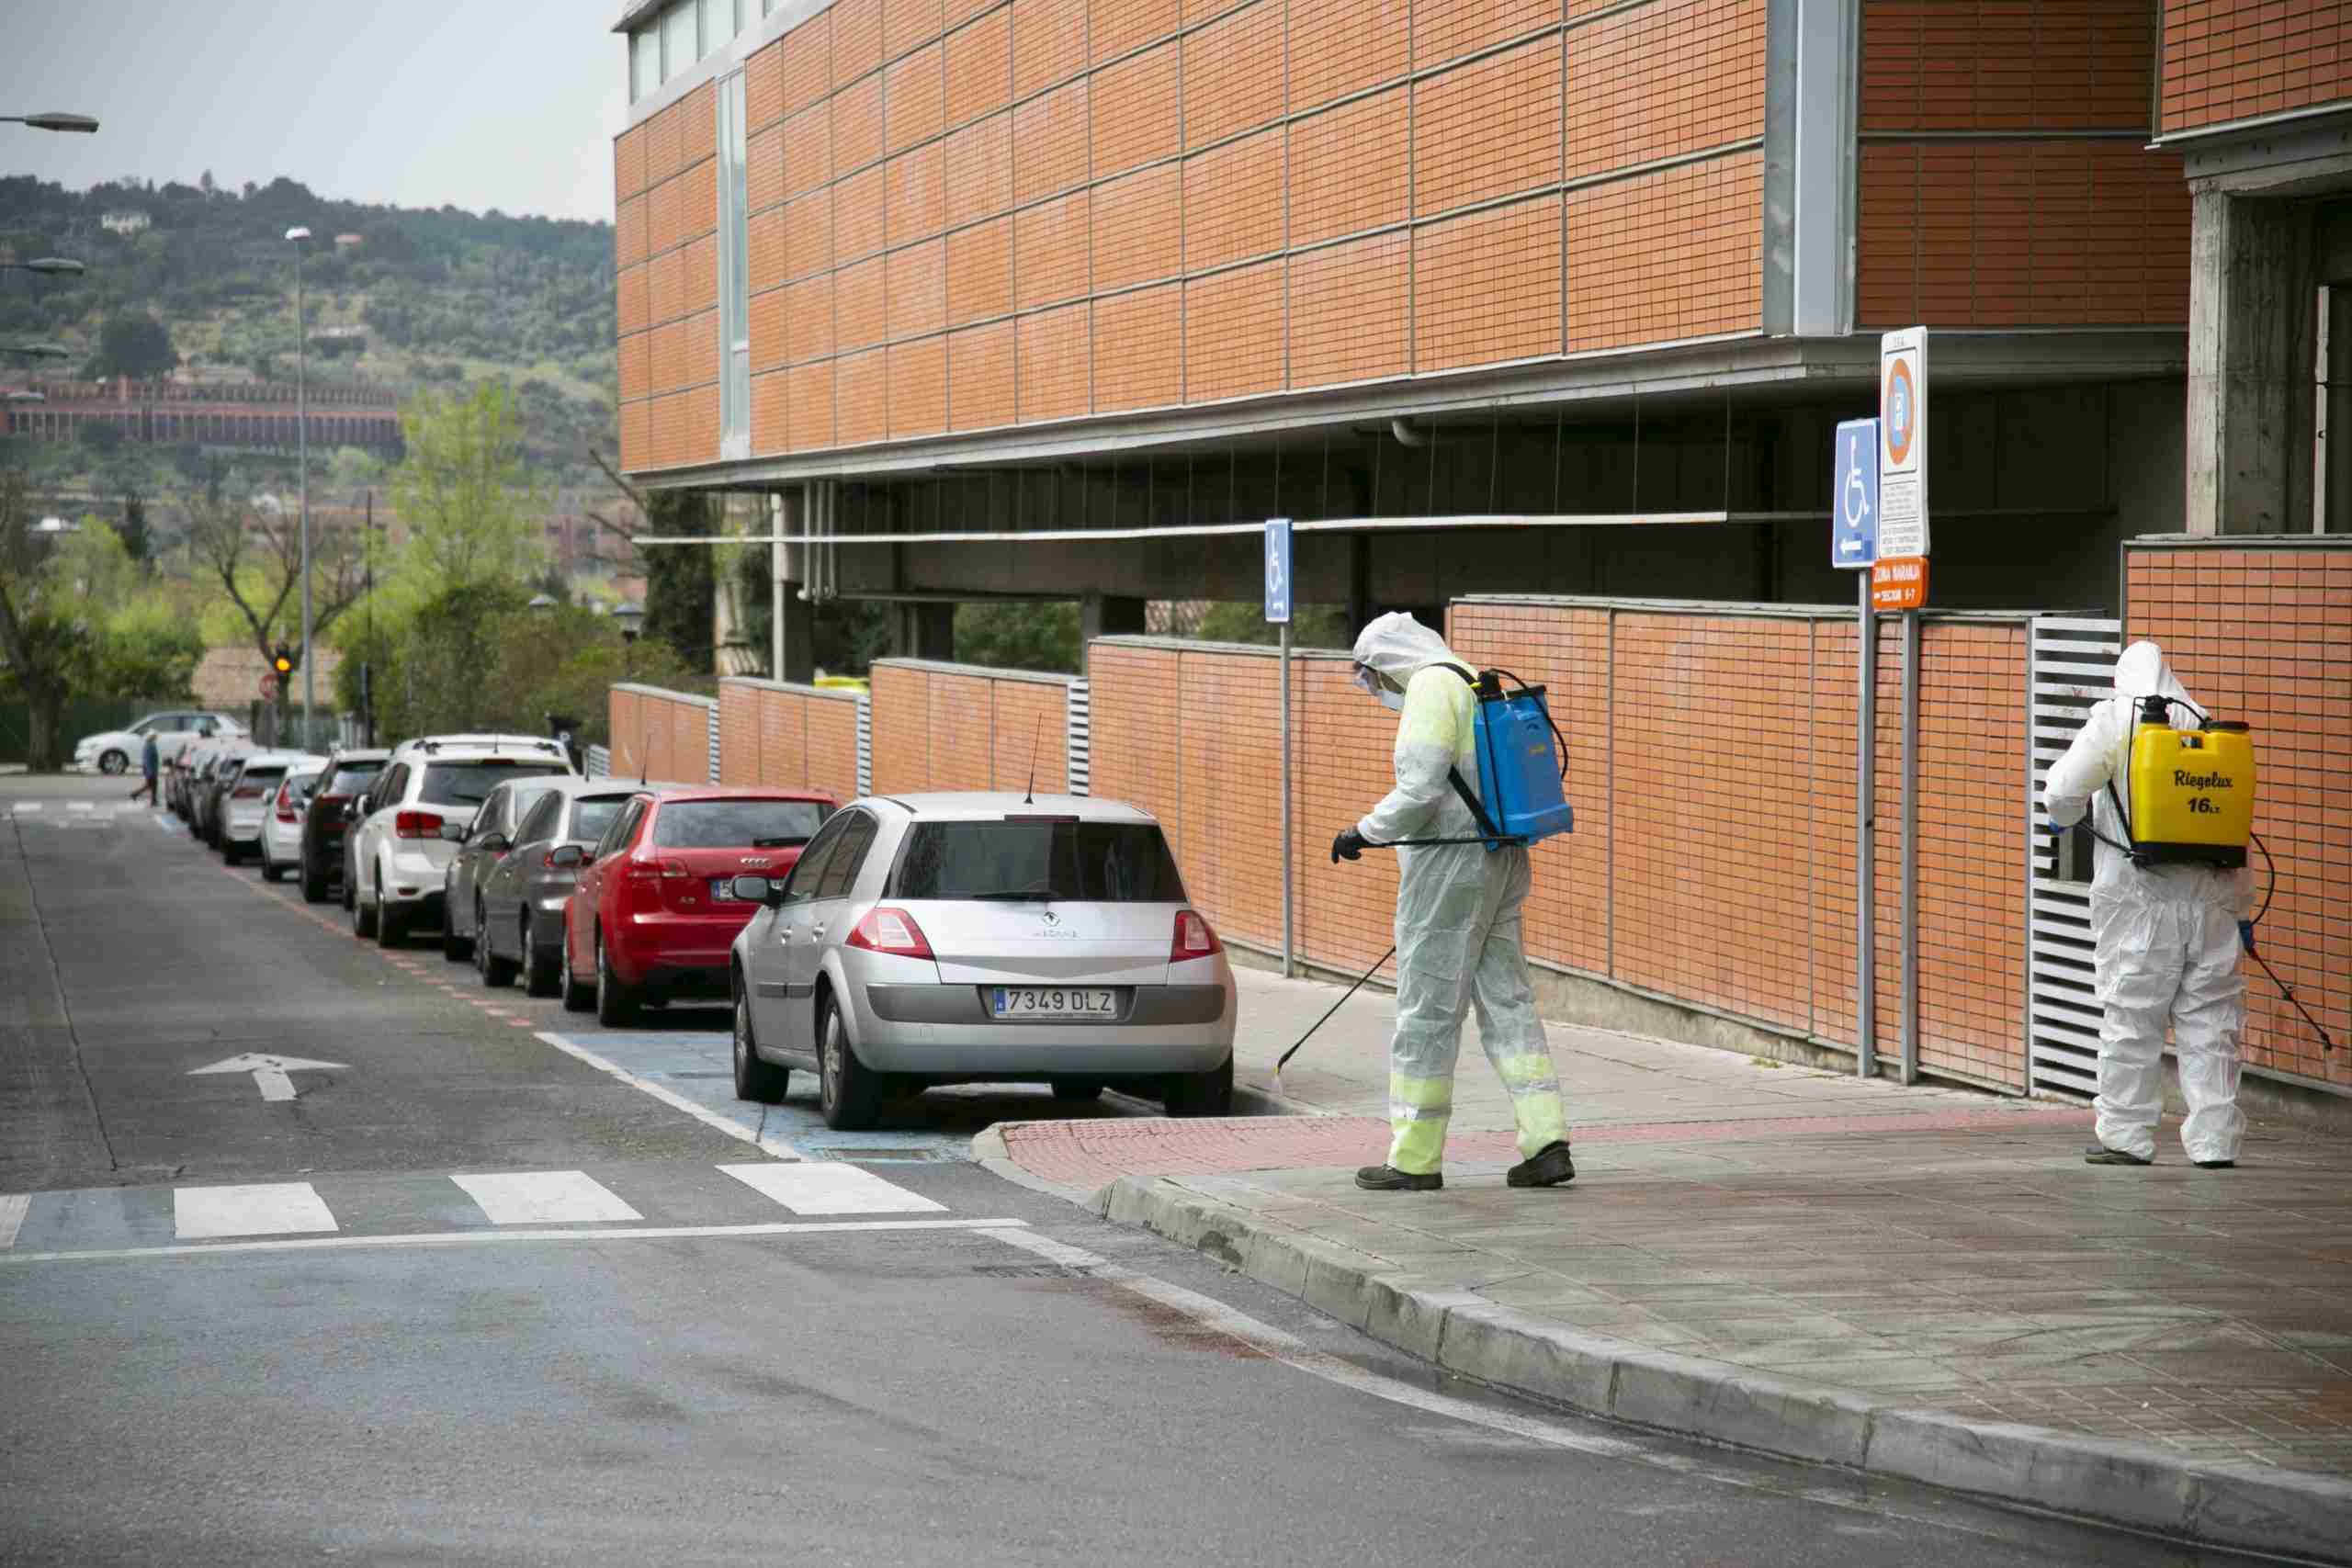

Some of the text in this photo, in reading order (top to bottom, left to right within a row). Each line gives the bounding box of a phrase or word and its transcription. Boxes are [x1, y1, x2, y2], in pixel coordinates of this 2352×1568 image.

[2174, 770, 2233, 791] Riegolux
[1010, 991, 1111, 1010] 7349 DLZ
